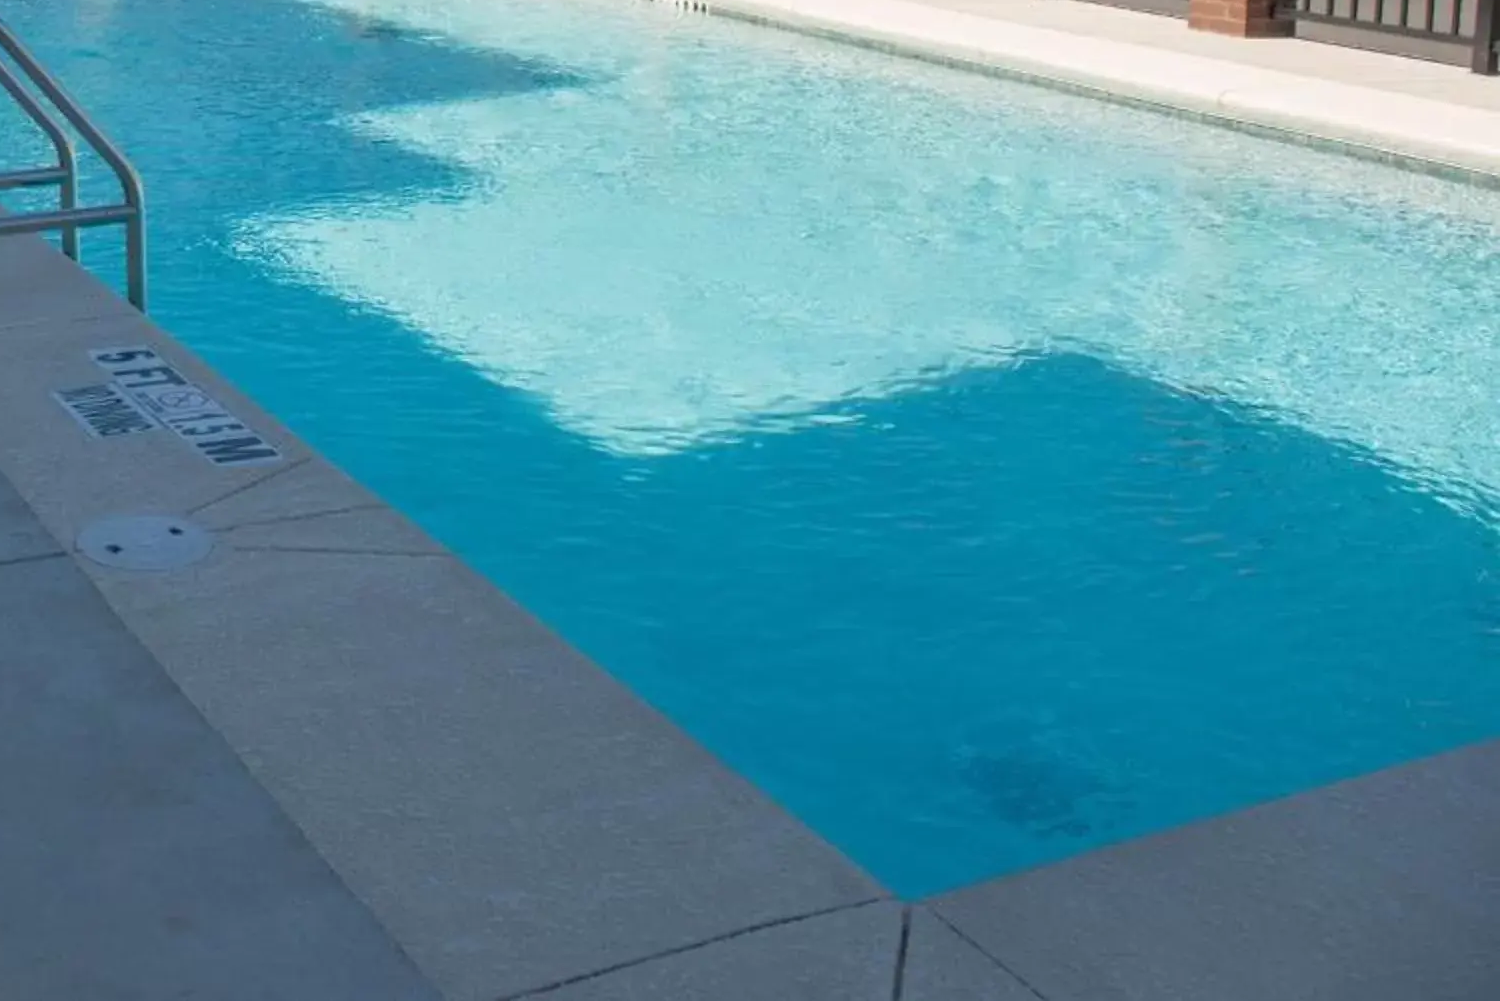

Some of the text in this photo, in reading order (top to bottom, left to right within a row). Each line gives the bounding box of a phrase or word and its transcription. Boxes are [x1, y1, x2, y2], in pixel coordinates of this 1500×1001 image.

[97, 350, 279, 464] 5 FT 1.5 M
